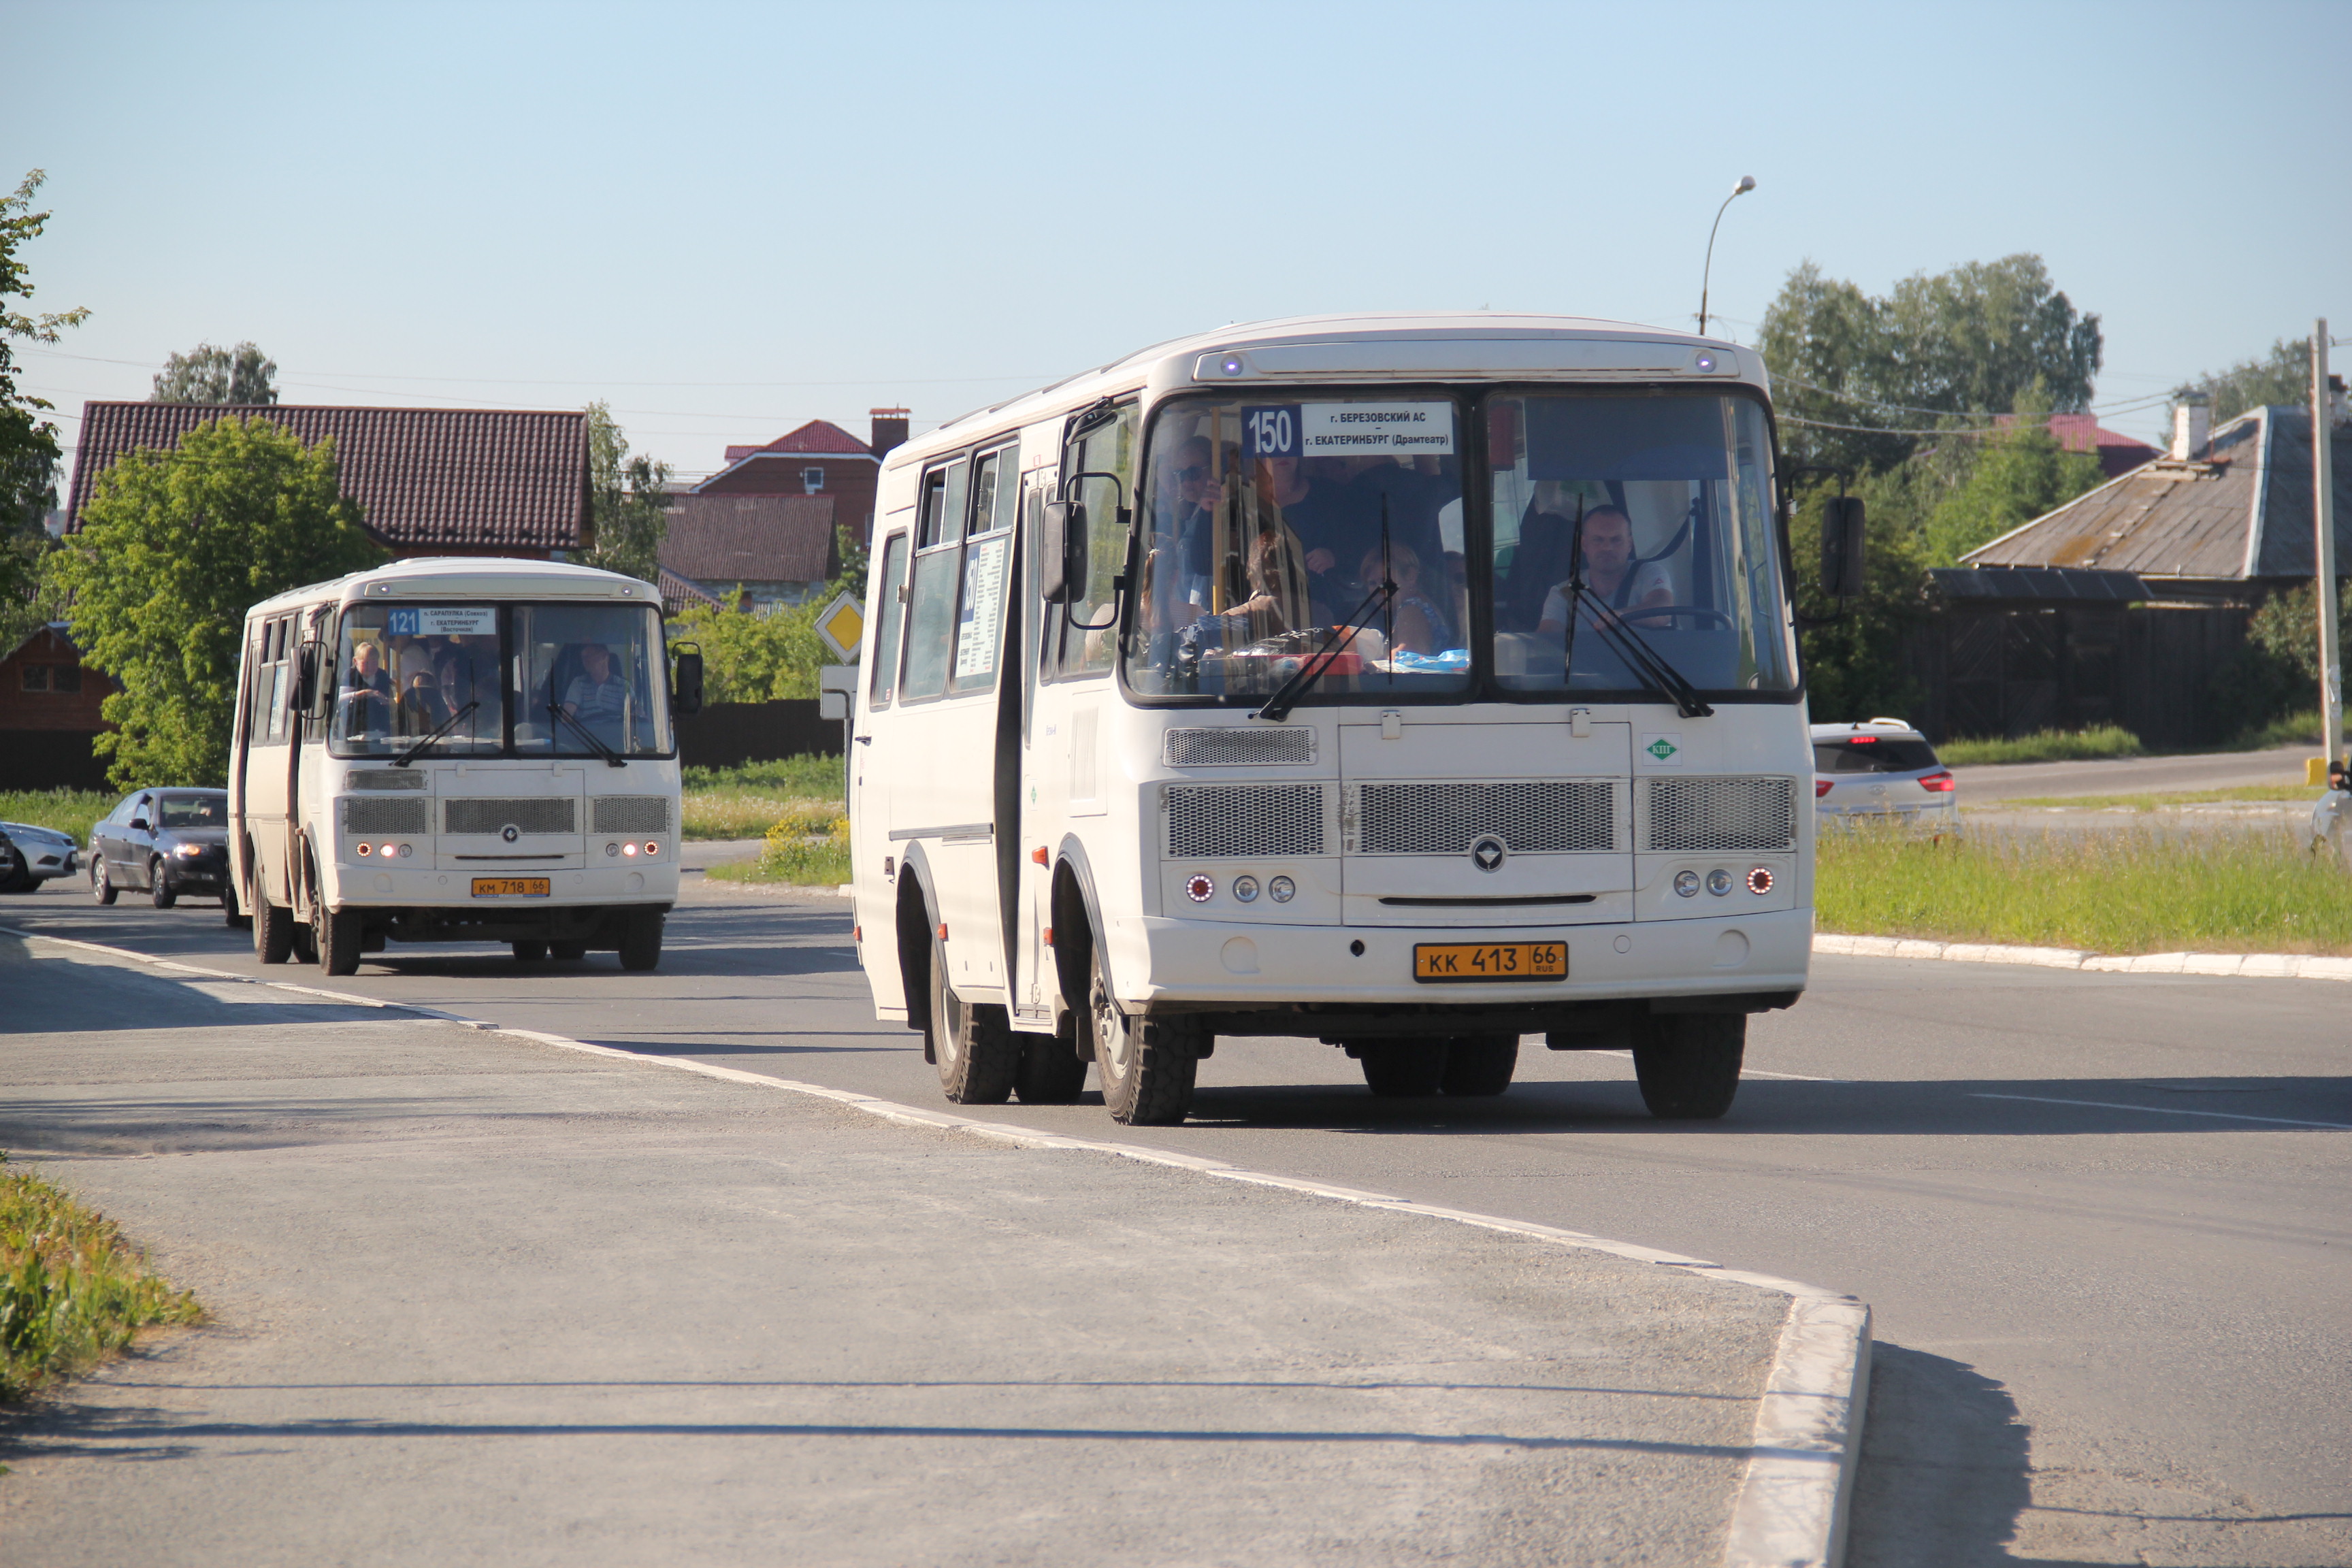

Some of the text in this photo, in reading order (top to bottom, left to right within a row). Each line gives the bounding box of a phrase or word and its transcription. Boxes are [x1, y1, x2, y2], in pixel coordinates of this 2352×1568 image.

[1340, 410, 1410, 423] БЕРЕЗОВСКИЙ
[1413, 412, 1426, 422] АС
[1248, 410, 1292, 453] 150
[1315, 435, 1389, 445] ЕКАТЕРИНБУРГ
[1392, 434, 1449, 446] (Драмтеатр)
[389, 612, 416, 633] 121
[1652, 745, 1671, 754] КПГ
[501, 881, 525, 894] 718
[532, 881, 544, 889] 66
[1471, 948, 1517, 972] 413
[1532, 946, 1556, 964] 66
